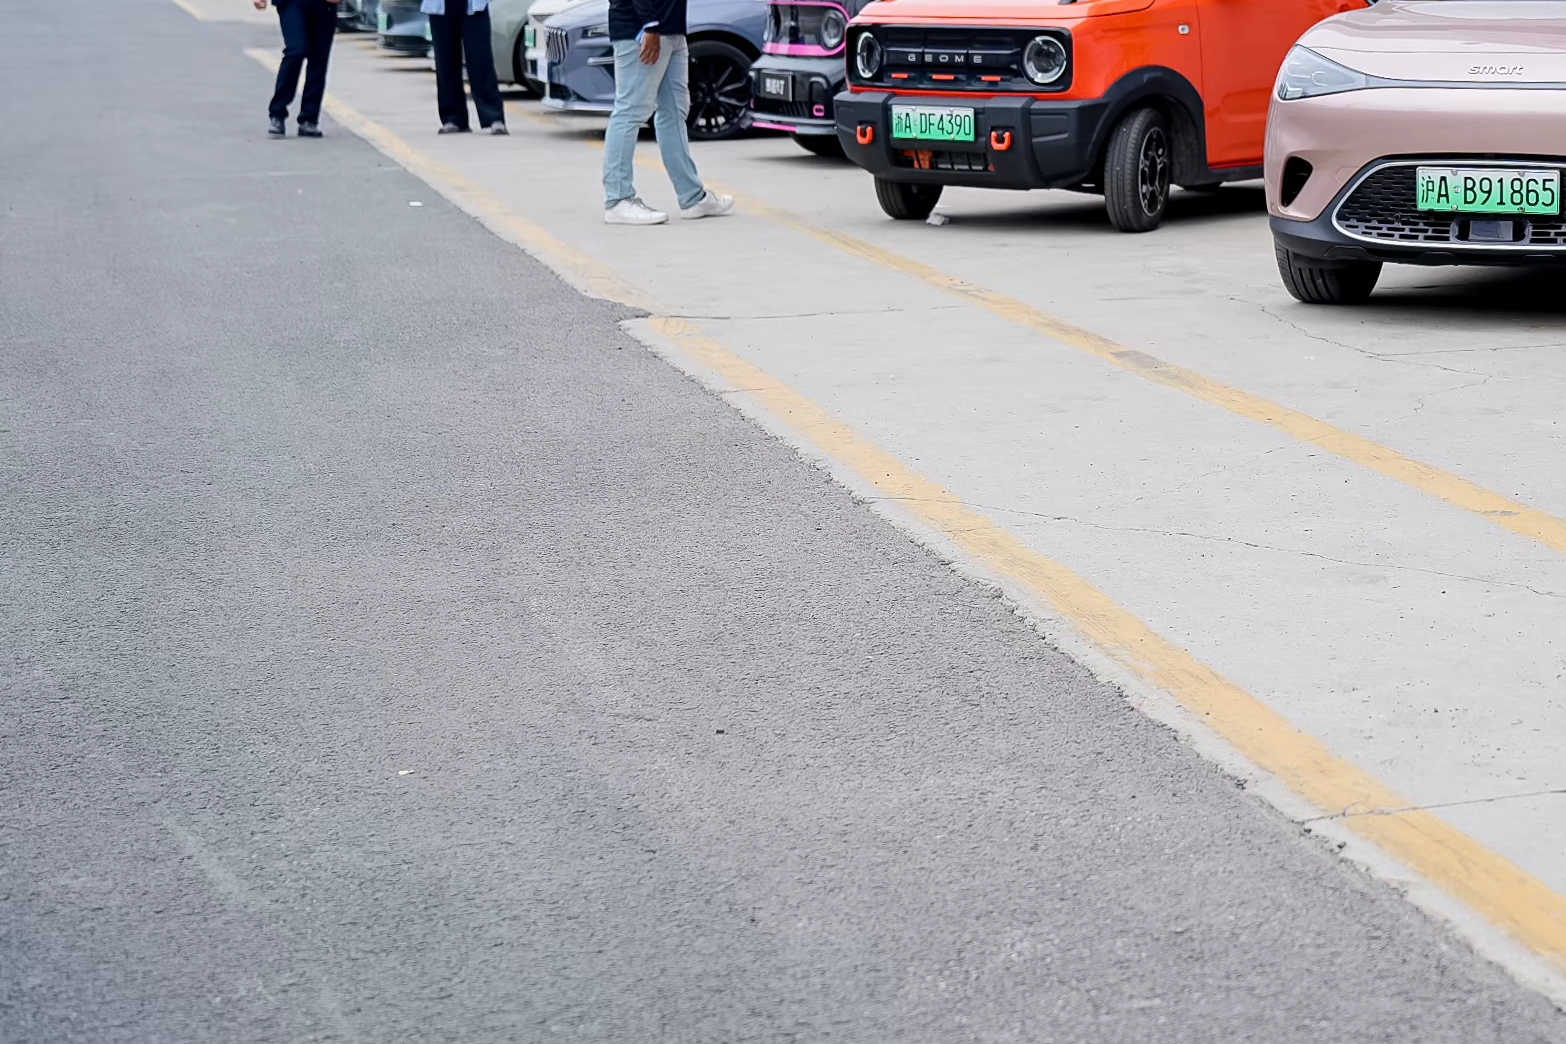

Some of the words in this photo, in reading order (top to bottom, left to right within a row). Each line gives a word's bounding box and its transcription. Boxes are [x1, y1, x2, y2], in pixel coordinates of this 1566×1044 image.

[908, 53, 982, 64] GEOME
[1467, 64, 1524, 76] smart
[919, 113, 971, 136] DF4390
[1421, 175, 1450, 204] 沪A
[1463, 176, 1555, 207] B91865
